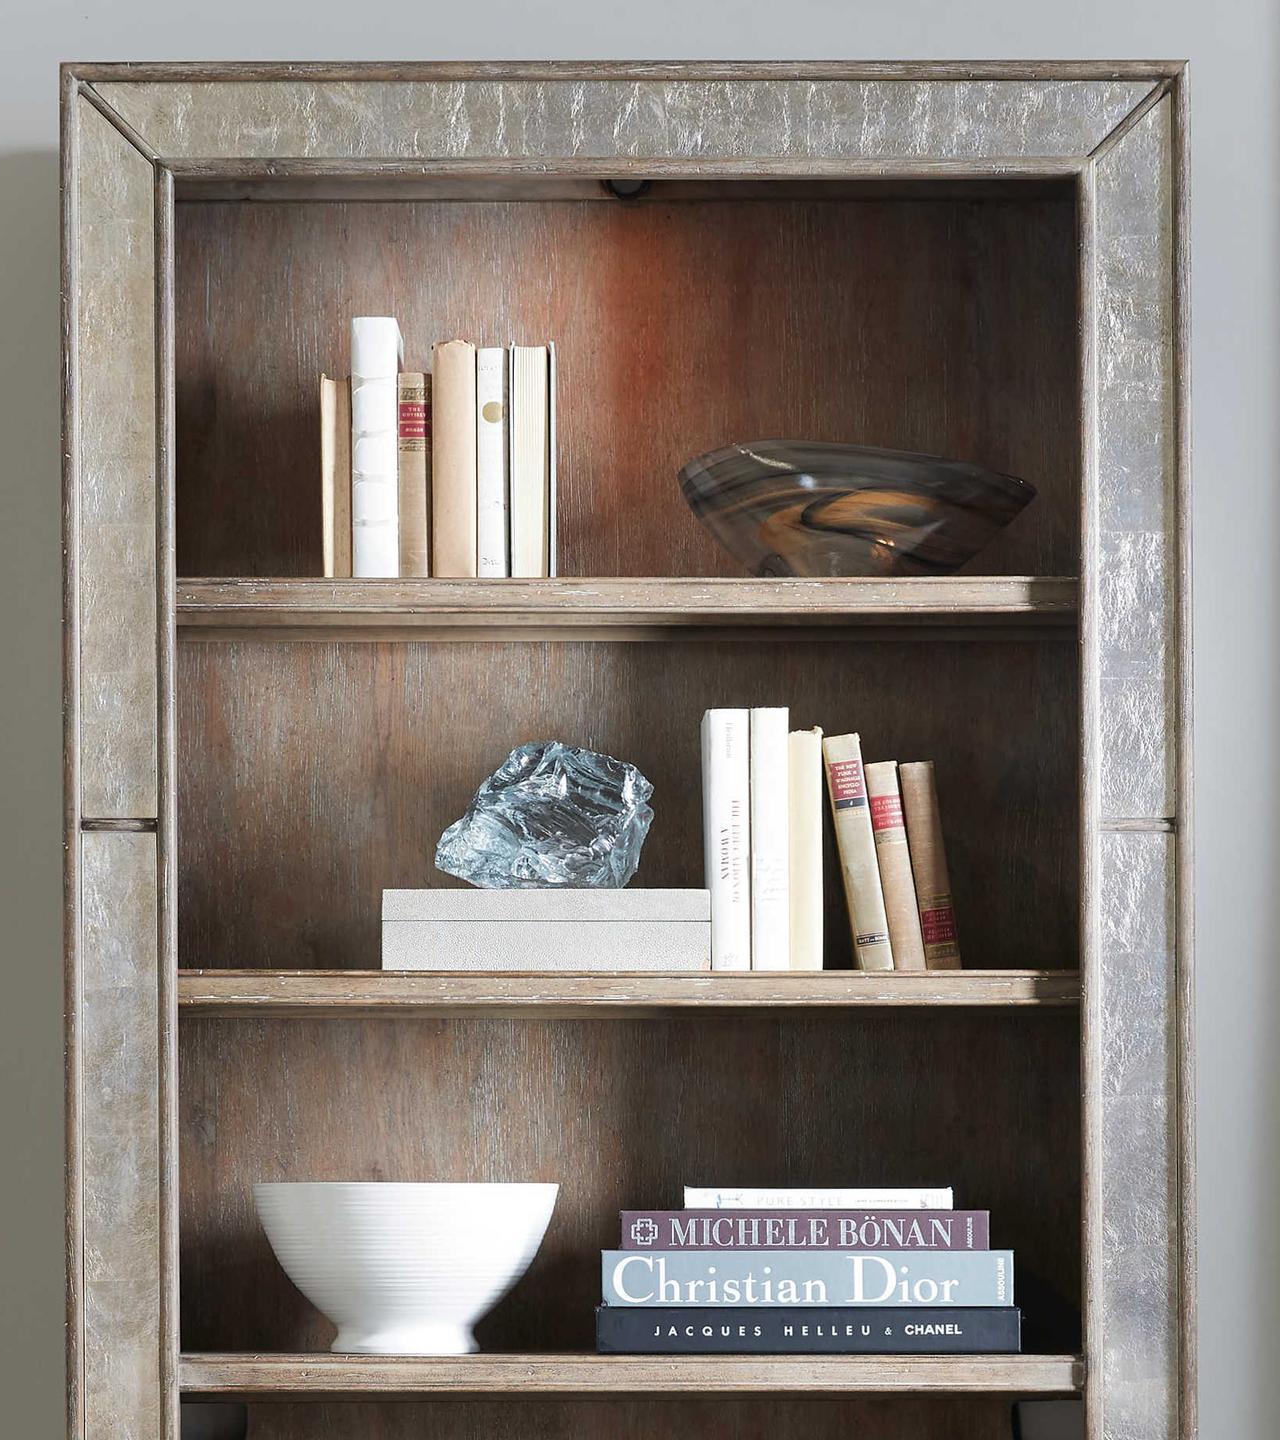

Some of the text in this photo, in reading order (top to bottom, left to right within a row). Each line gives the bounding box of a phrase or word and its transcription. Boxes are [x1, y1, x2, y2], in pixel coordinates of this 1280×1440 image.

[720, 835, 730, 880] WOMAN
[800, 1196, 842, 1207] STYLE
[668, 1215, 954, 1247] MICHELE BÖNAN
[612, 1254, 960, 1304] Christian Dior
[996, 1257, 1005, 1301] ASSOULINE
[653, 1324, 963, 1338] JACQUES HELLEU & CHANEL
